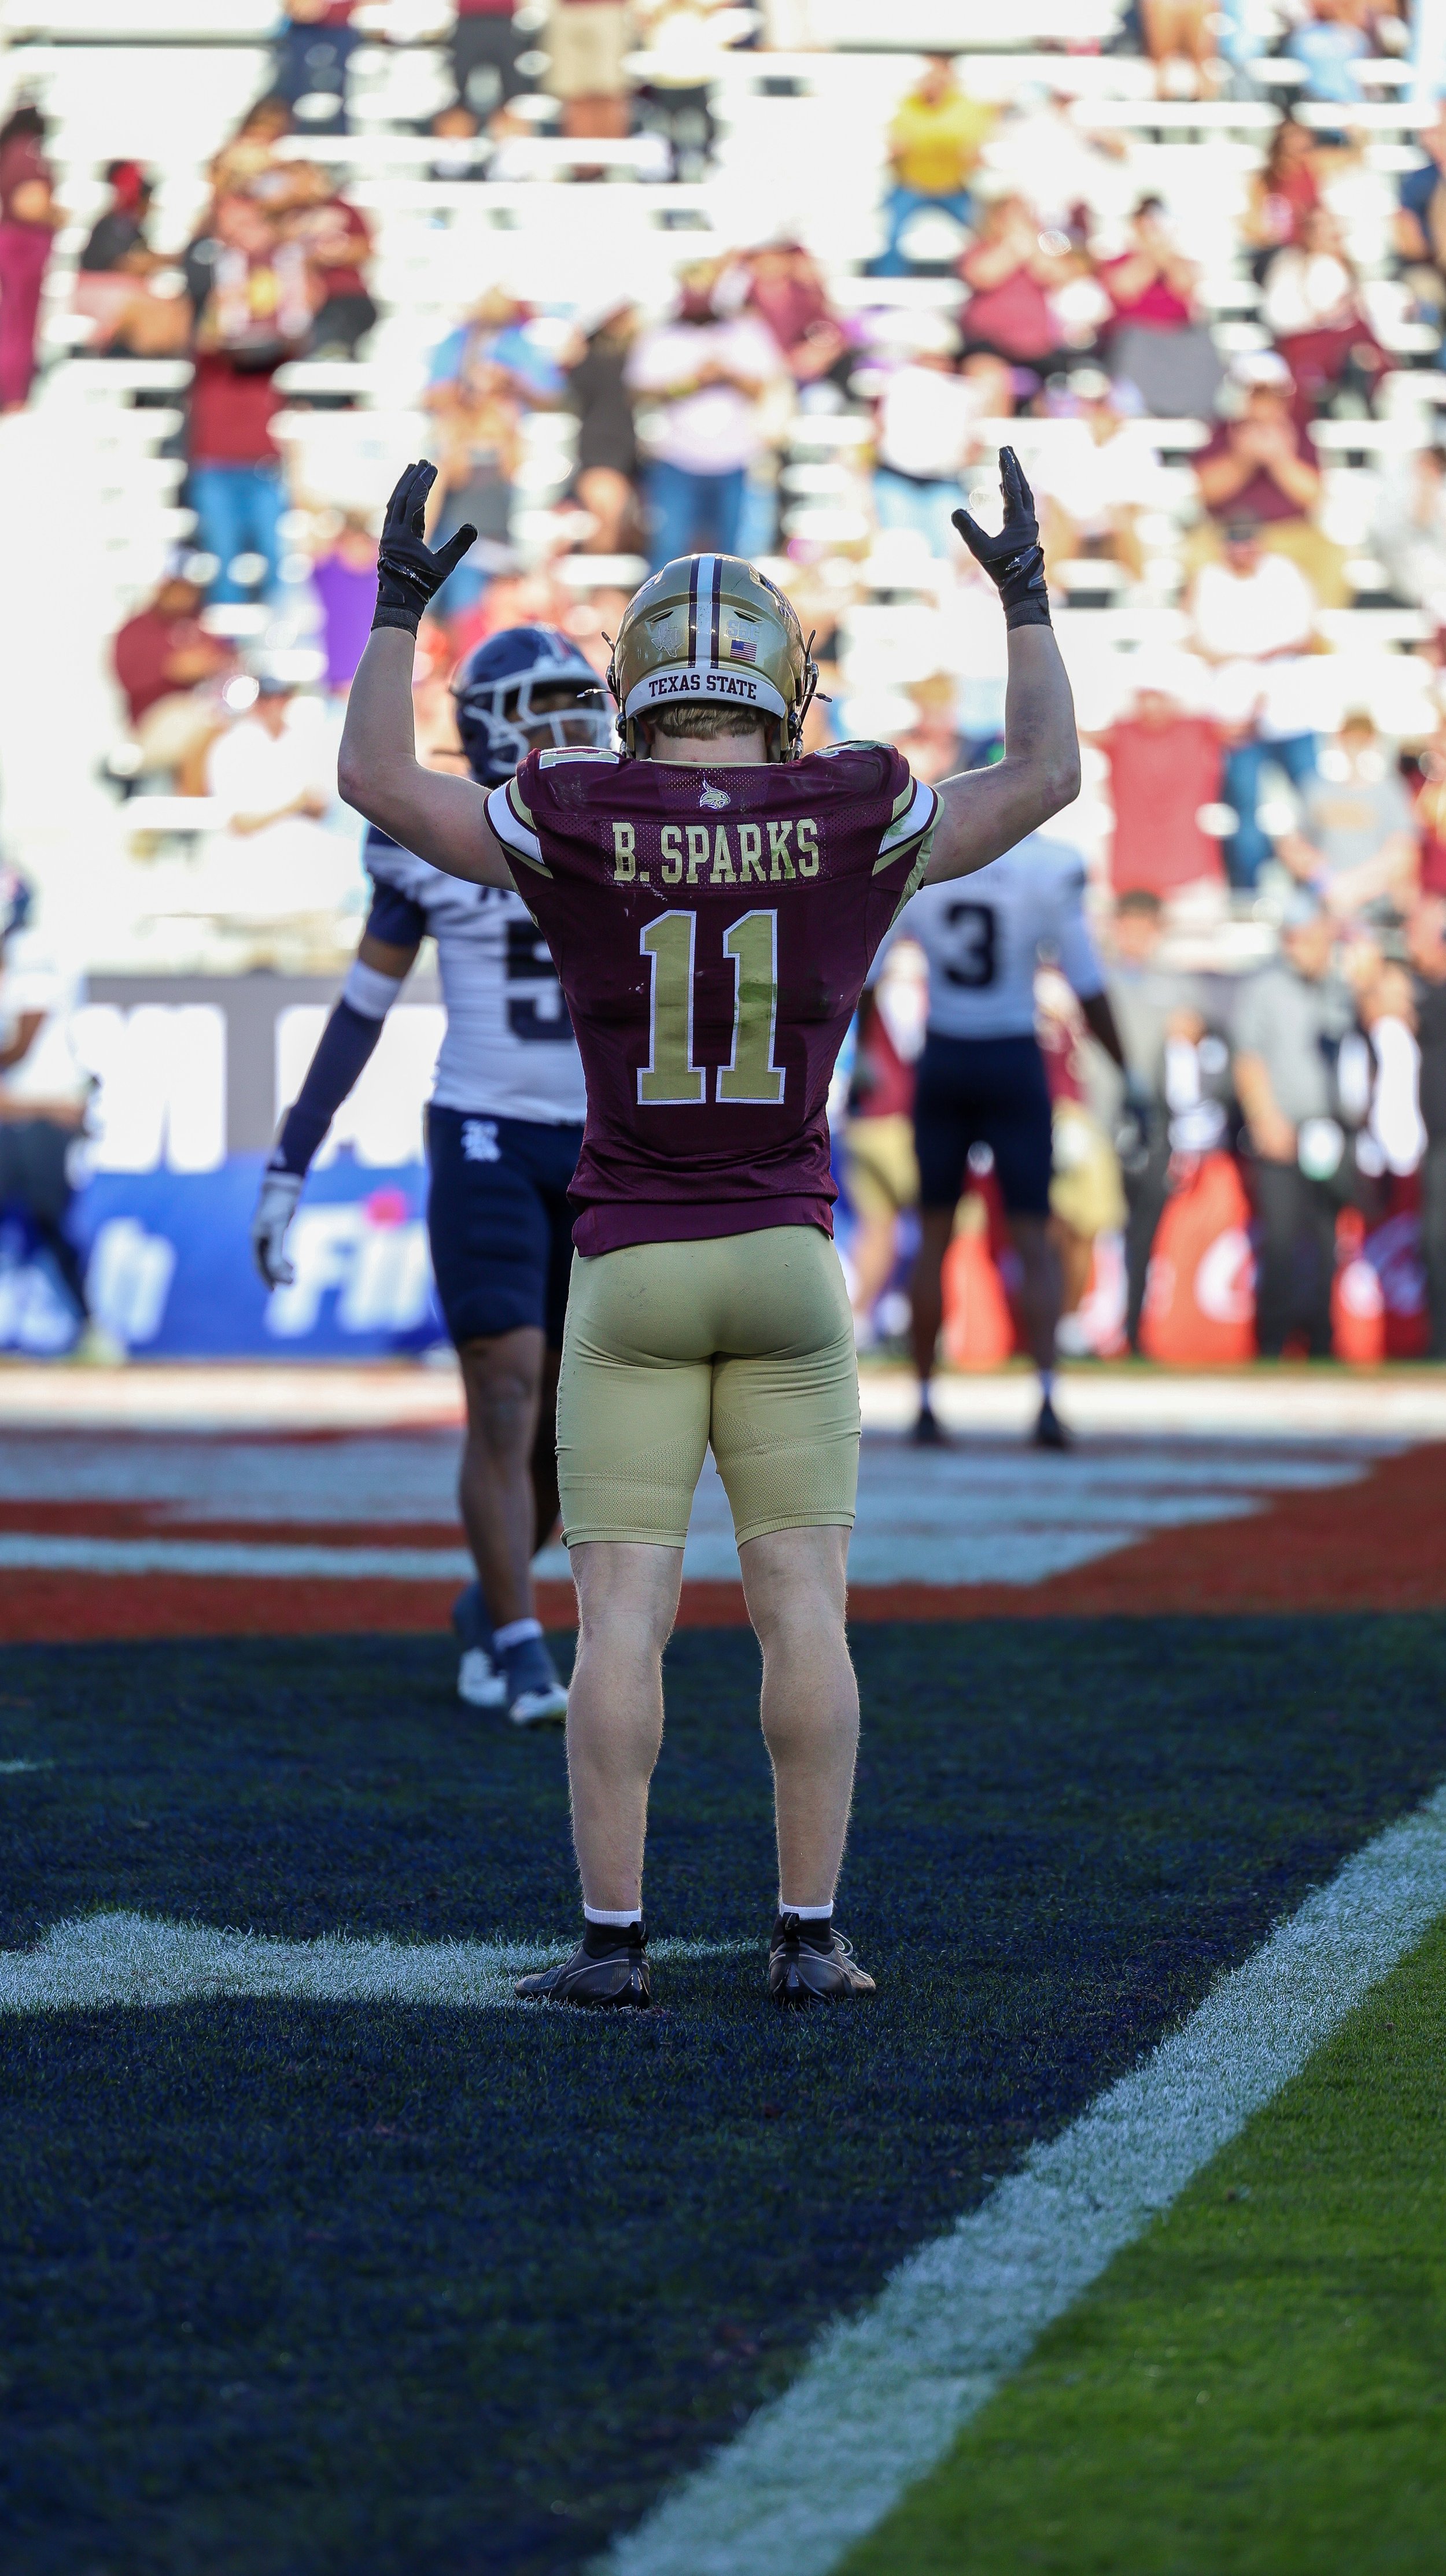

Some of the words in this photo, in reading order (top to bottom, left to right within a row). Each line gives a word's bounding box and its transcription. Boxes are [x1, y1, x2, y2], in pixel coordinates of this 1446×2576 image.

[648, 674, 700, 697] TEXAS
[706, 675, 757, 700] STATE
[613, 823, 650, 882] B.
[661, 818, 819, 884] SPARKS
[506, 918, 578, 1046] 5
[943, 900, 996, 988] 3
[637, 908, 786, 1104] 11
